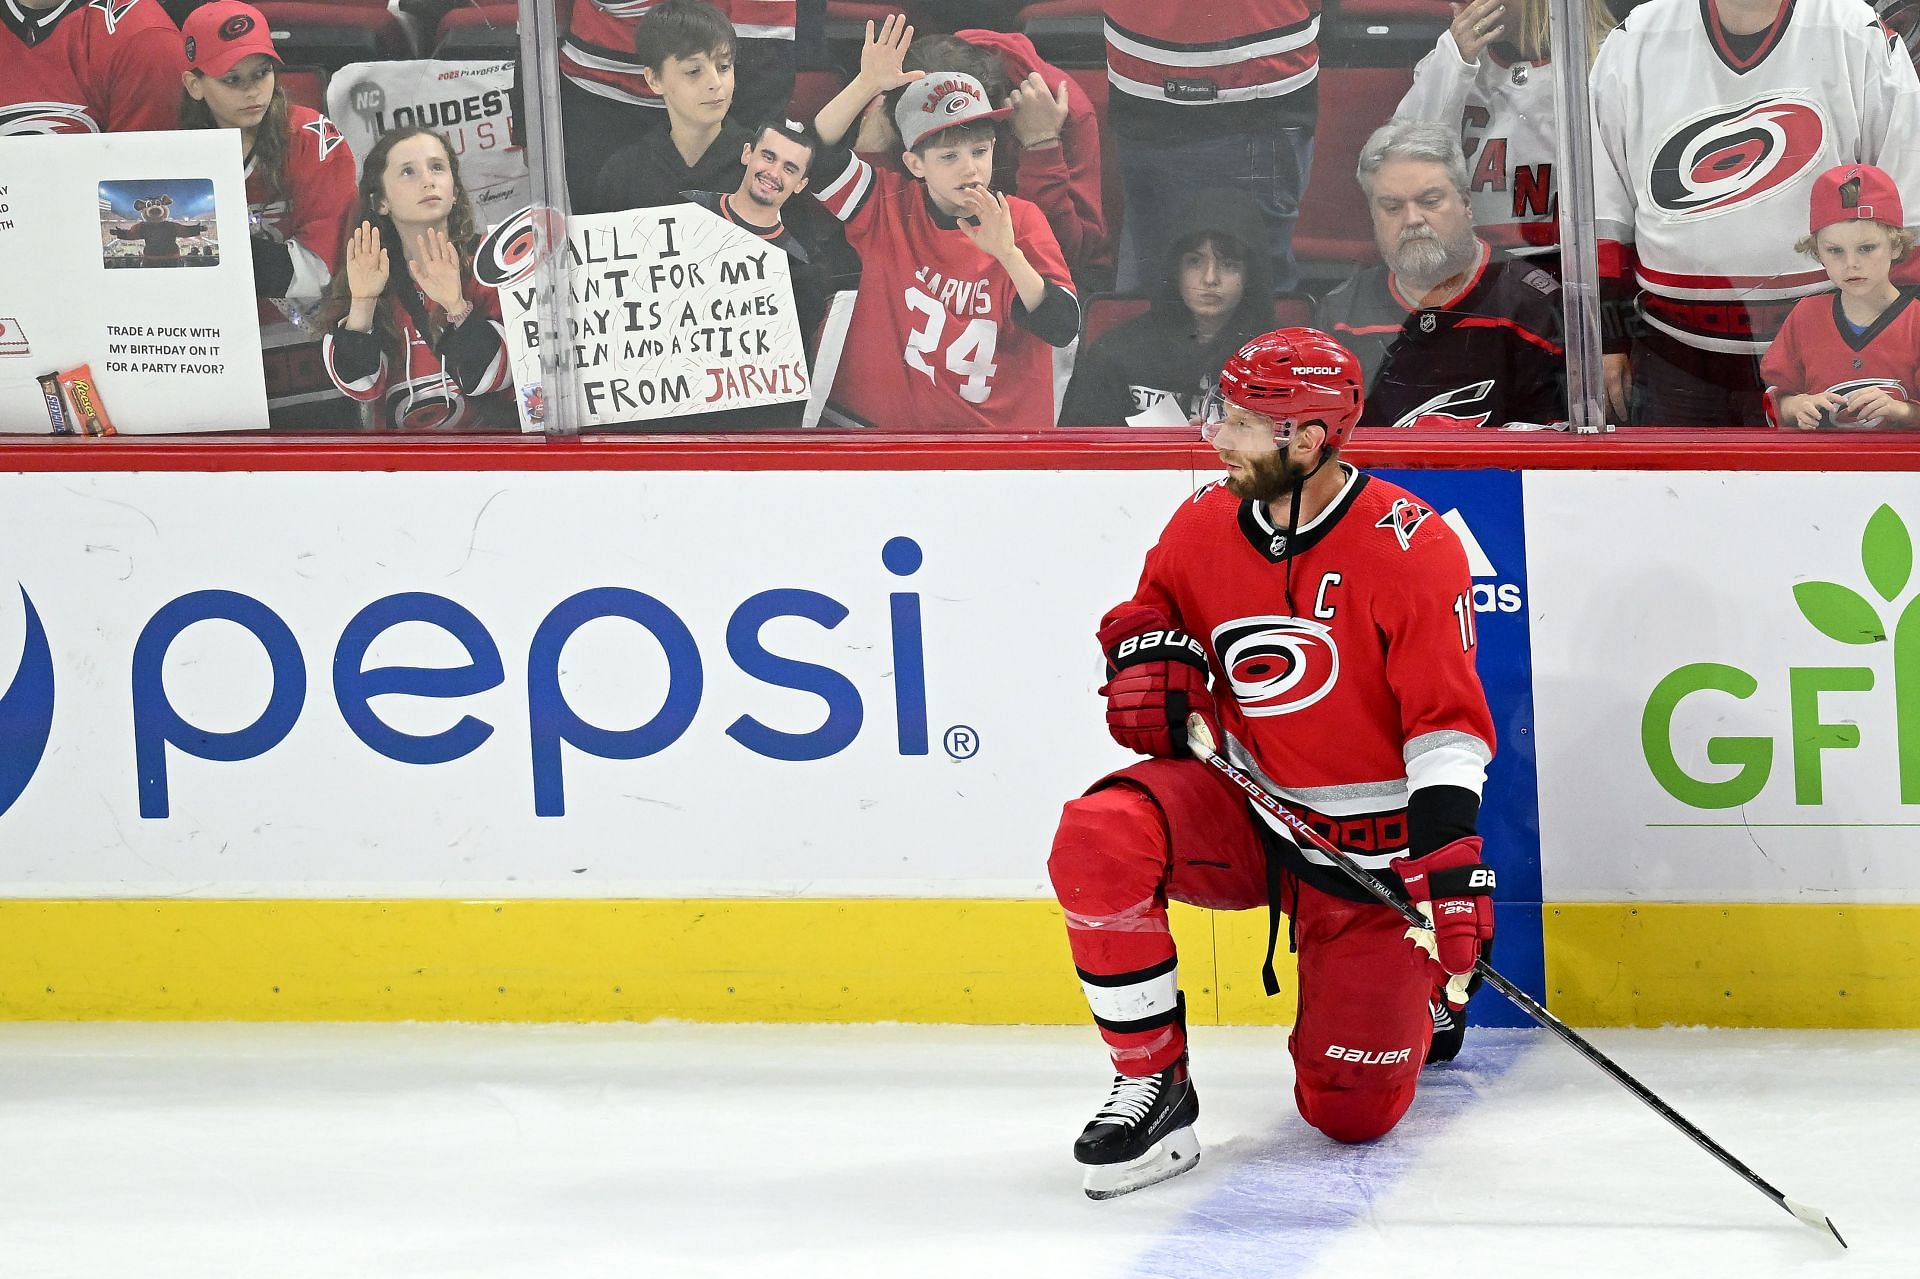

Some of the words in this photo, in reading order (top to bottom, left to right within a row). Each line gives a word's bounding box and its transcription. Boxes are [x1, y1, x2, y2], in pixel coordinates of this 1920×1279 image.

[461, 65, 500, 77] PLAYOFFS
[356, 90, 380, 110] NC
[921, 79, 981, 114] CAROLINA
[1461, 104, 1560, 225] CAN
[658, 217, 681, 259] I
[649, 262, 705, 293] FOR
[720, 250, 768, 285] MY
[915, 266, 992, 316] JARVIS
[623, 301, 662, 332] IS
[680, 300, 698, 328] A
[711, 293, 779, 321] CANES
[107, 325, 144, 336] TRADE
[146, 327, 155, 337] A
[157, 327, 187, 337] PUCK
[190, 328, 221, 338] WITH
[623, 338, 664, 360] AND
[671, 335, 682, 355] A
[690, 327, 770, 358] STICK
[904, 286, 998, 404] 24
[109, 344, 127, 354] MY
[130, 344, 186, 355] BIRTHDAY
[189, 346, 207, 356] ON
[210, 346, 220, 356] IT
[106, 362, 128, 372] FOR
[130, 362, 139, 372] A
[141, 363, 177, 373] PARTY
[180, 364, 225, 374] FAVOR?
[1291, 366, 1342, 376] TOPGOLF
[583, 375, 690, 415] FROM
[705, 361, 807, 403] JARVIS
[1313, 571, 1342, 620] C
[1453, 587, 1475, 653] 11
[131, 535, 929, 819] pepsi
[1438, 901, 1476, 909] NEXUS
[1324, 1044, 1412, 1065] BAUER
[1147, 1105, 1170, 1135] BAUER
